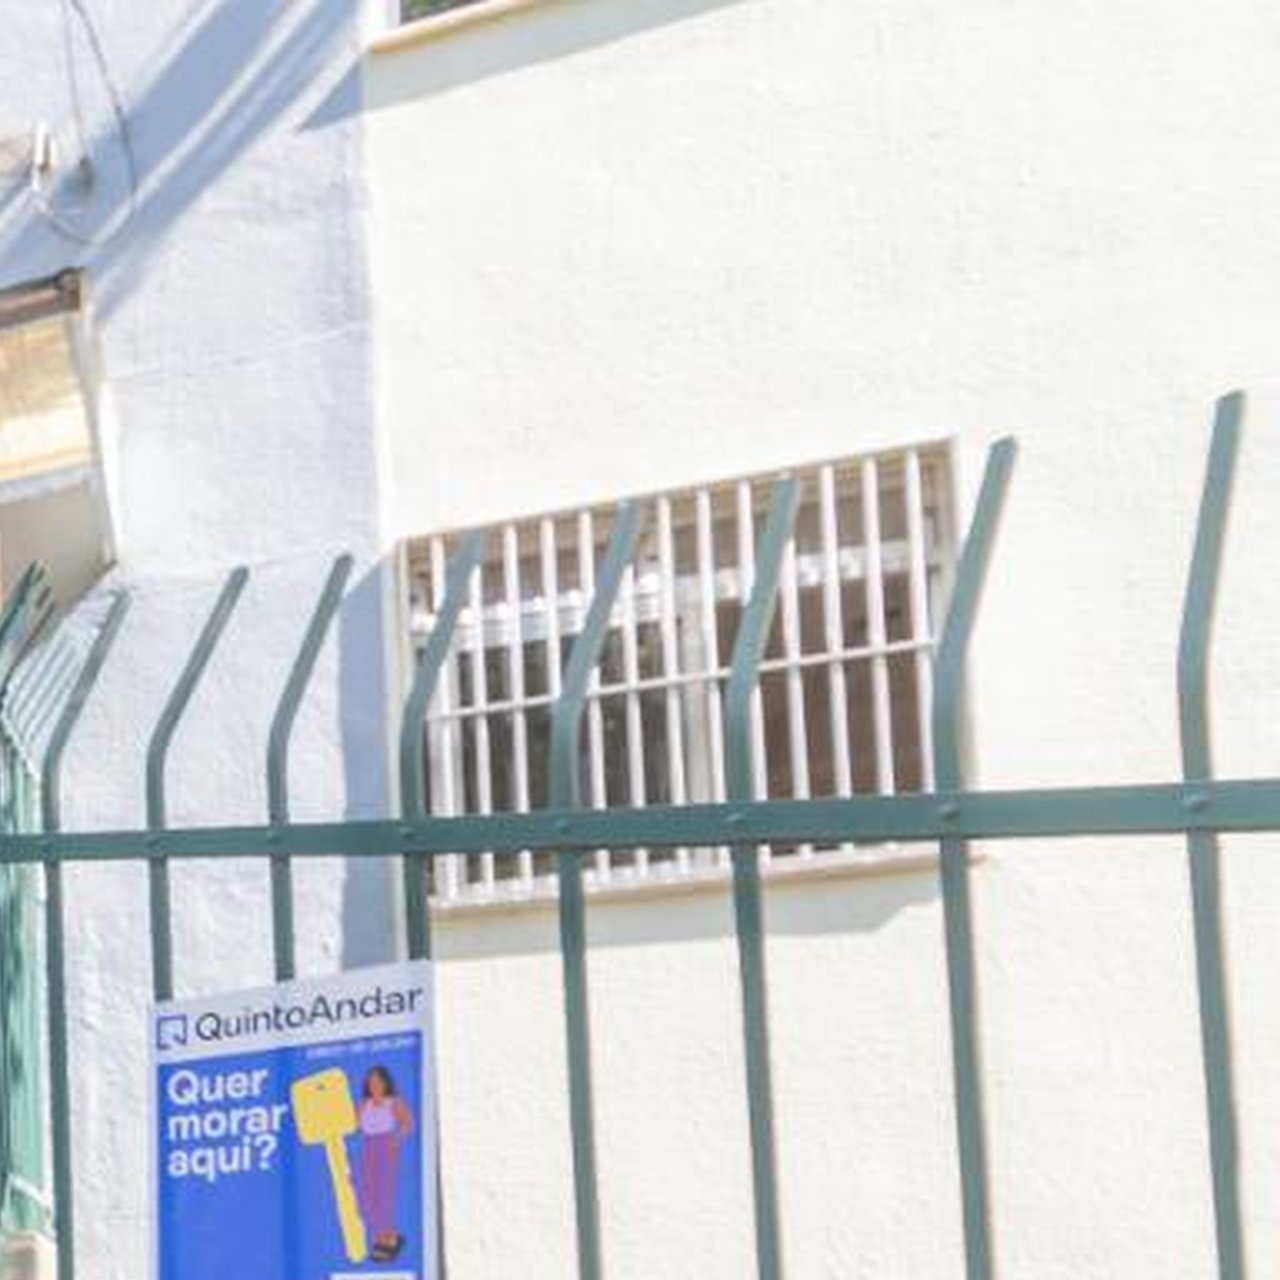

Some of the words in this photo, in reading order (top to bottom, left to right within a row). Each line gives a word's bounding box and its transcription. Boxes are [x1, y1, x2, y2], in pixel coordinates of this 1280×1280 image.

[195, 986, 423, 1042] QuintoAndar
[166, 1067, 269, 1106] Quer
[167, 1103, 288, 1142] morar
[167, 1136, 278, 1183] aqui?
